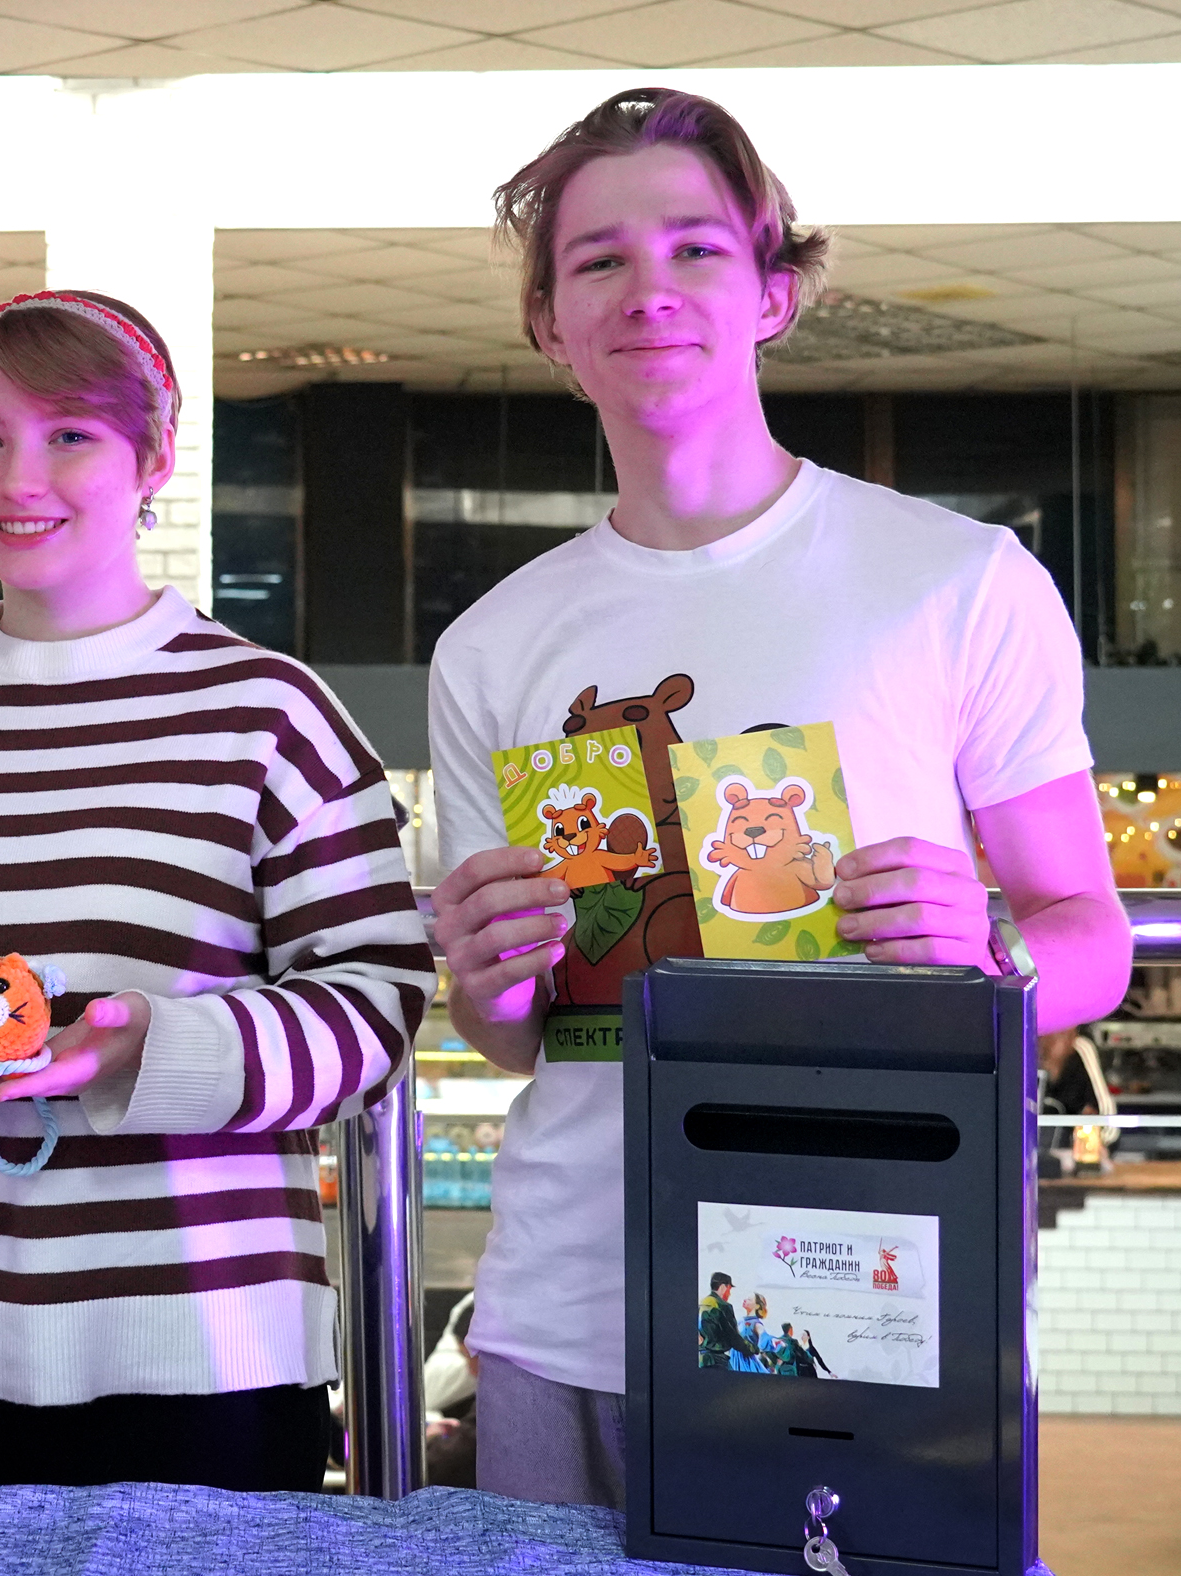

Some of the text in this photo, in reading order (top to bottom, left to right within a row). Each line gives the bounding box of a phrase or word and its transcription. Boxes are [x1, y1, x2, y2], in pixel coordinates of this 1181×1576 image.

[502, 740, 632, 788] ДОБРО
[800, 1241, 853, 1256] ПАТРИОТ И
[800, 1257, 860, 1272] ГРАЖДАНИН
[872, 1269, 887, 1282] 80
[872, 1282, 899, 1291] ПОБЕДА!
